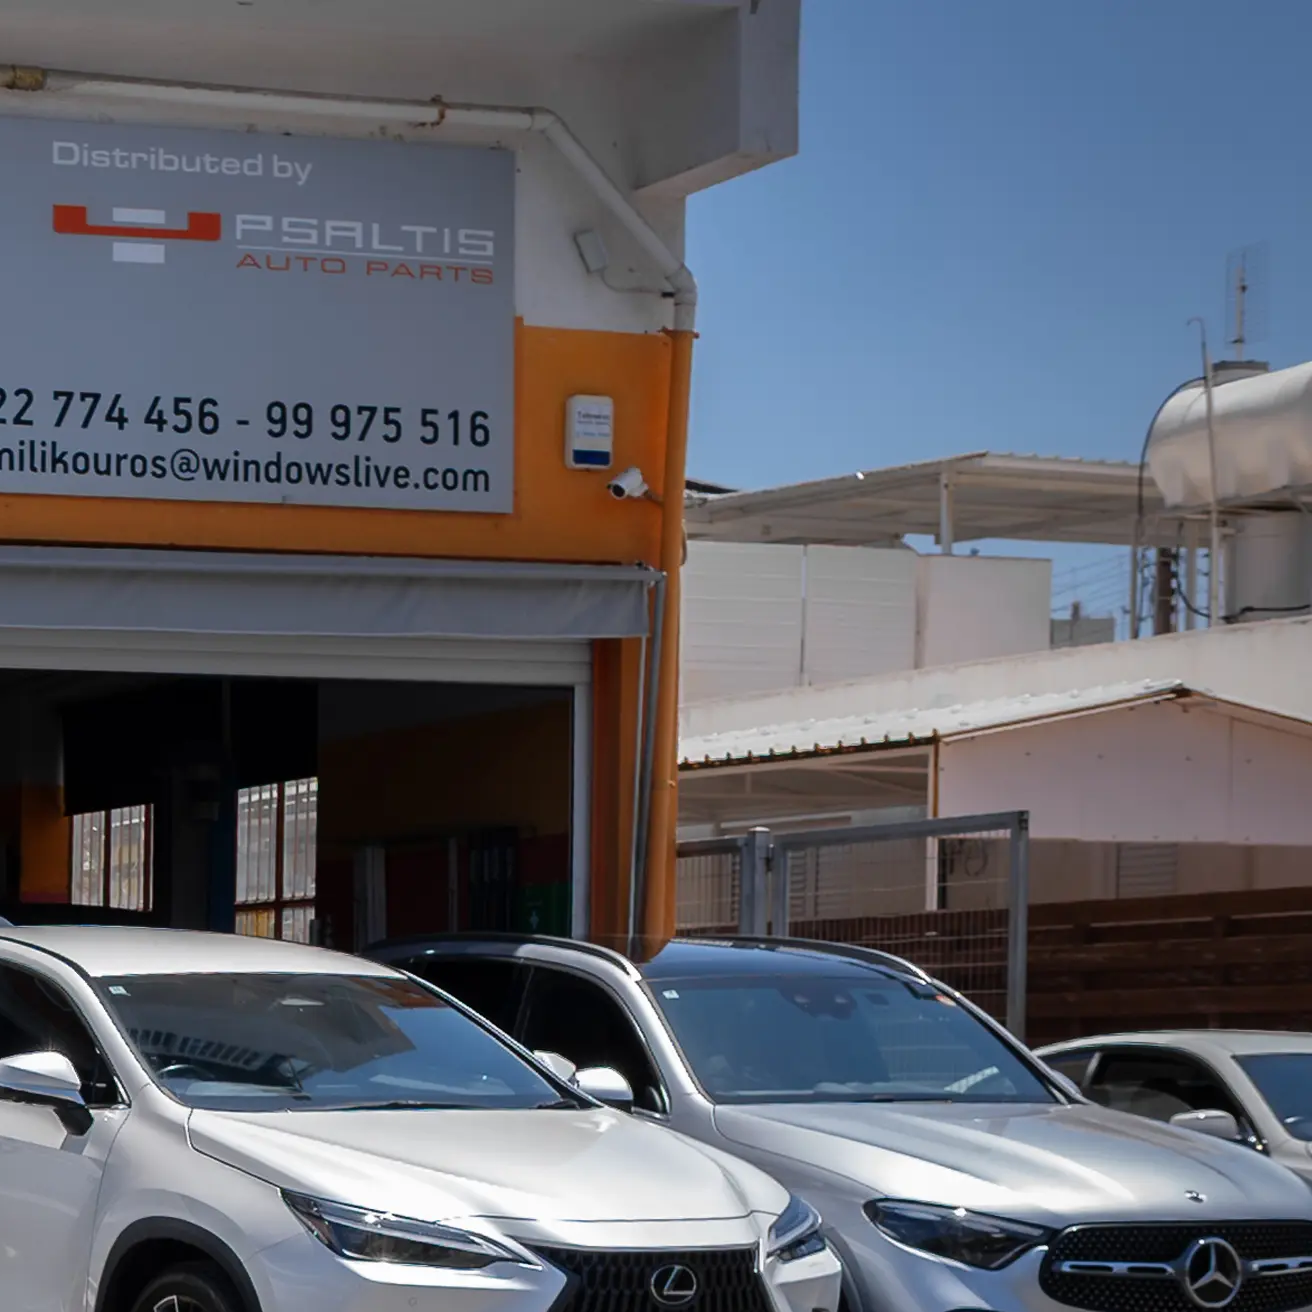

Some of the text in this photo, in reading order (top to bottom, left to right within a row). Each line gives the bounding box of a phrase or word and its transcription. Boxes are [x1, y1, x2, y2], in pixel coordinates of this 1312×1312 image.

[52, 140, 313, 187] Distributed by
[235, 213, 494, 256] PSALTIS
[236, 253, 494, 285] AUTO PARTS
[52, 390, 129, 431] 774
[143, 395, 220, 436] 456
[266, 400, 313, 440] 99
[330, 403, 402, 444] 975
[419, 408, 490, 448] 516
